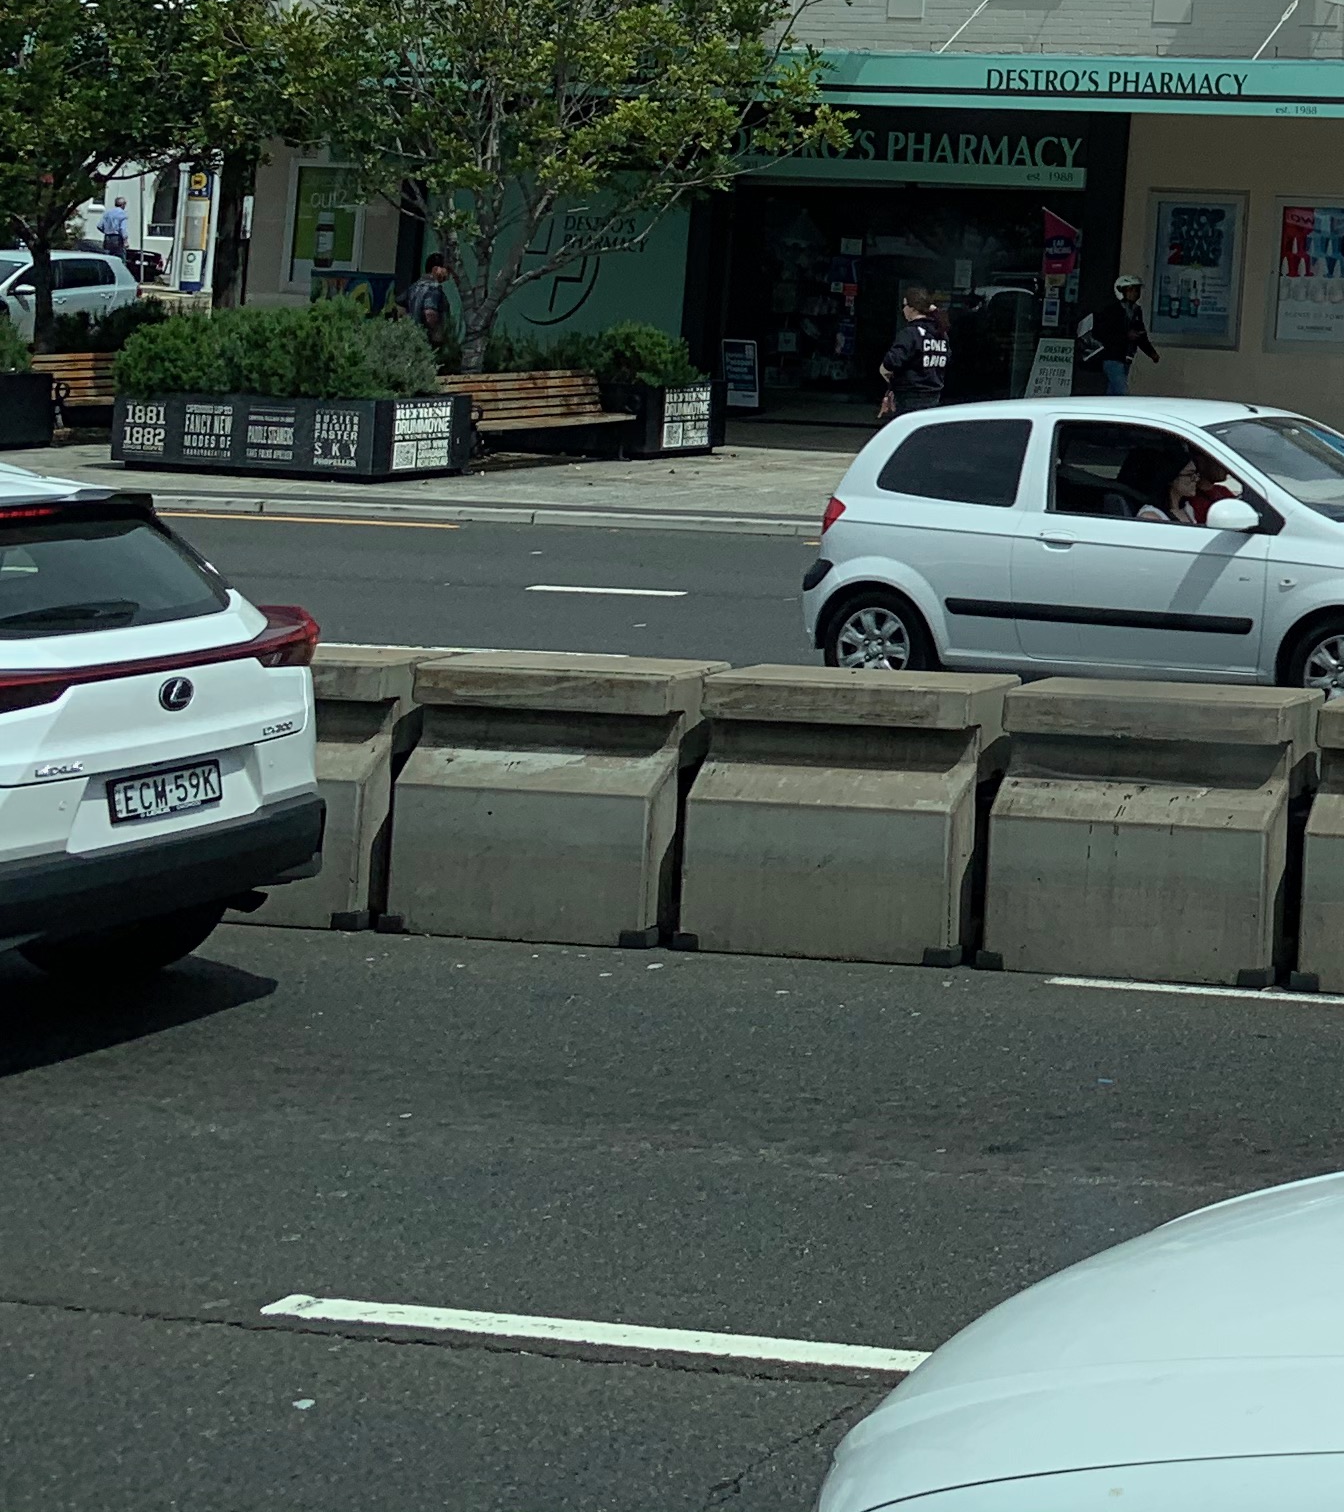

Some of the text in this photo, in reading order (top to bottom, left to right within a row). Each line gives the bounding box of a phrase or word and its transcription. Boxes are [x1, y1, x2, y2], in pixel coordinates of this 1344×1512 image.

[986, 69, 1247, 96] DESTRO'S PHARMACY
[1296, 106, 1317, 115] 1988
[887, 131, 1083, 169] PHARMACY
[1049, 171, 1074, 182] 1988
[125, 405, 166, 425] 1881
[185, 415, 212, 433] FANCY
[213, 416, 233, 435] NEW
[394, 418, 450, 434] DRUMMOYNE
[123, 426, 166, 446] 1882
[184, 435, 231, 448] MODES OF
[314, 430, 358, 440] FASTER
[313, 442, 358, 457] SKY
